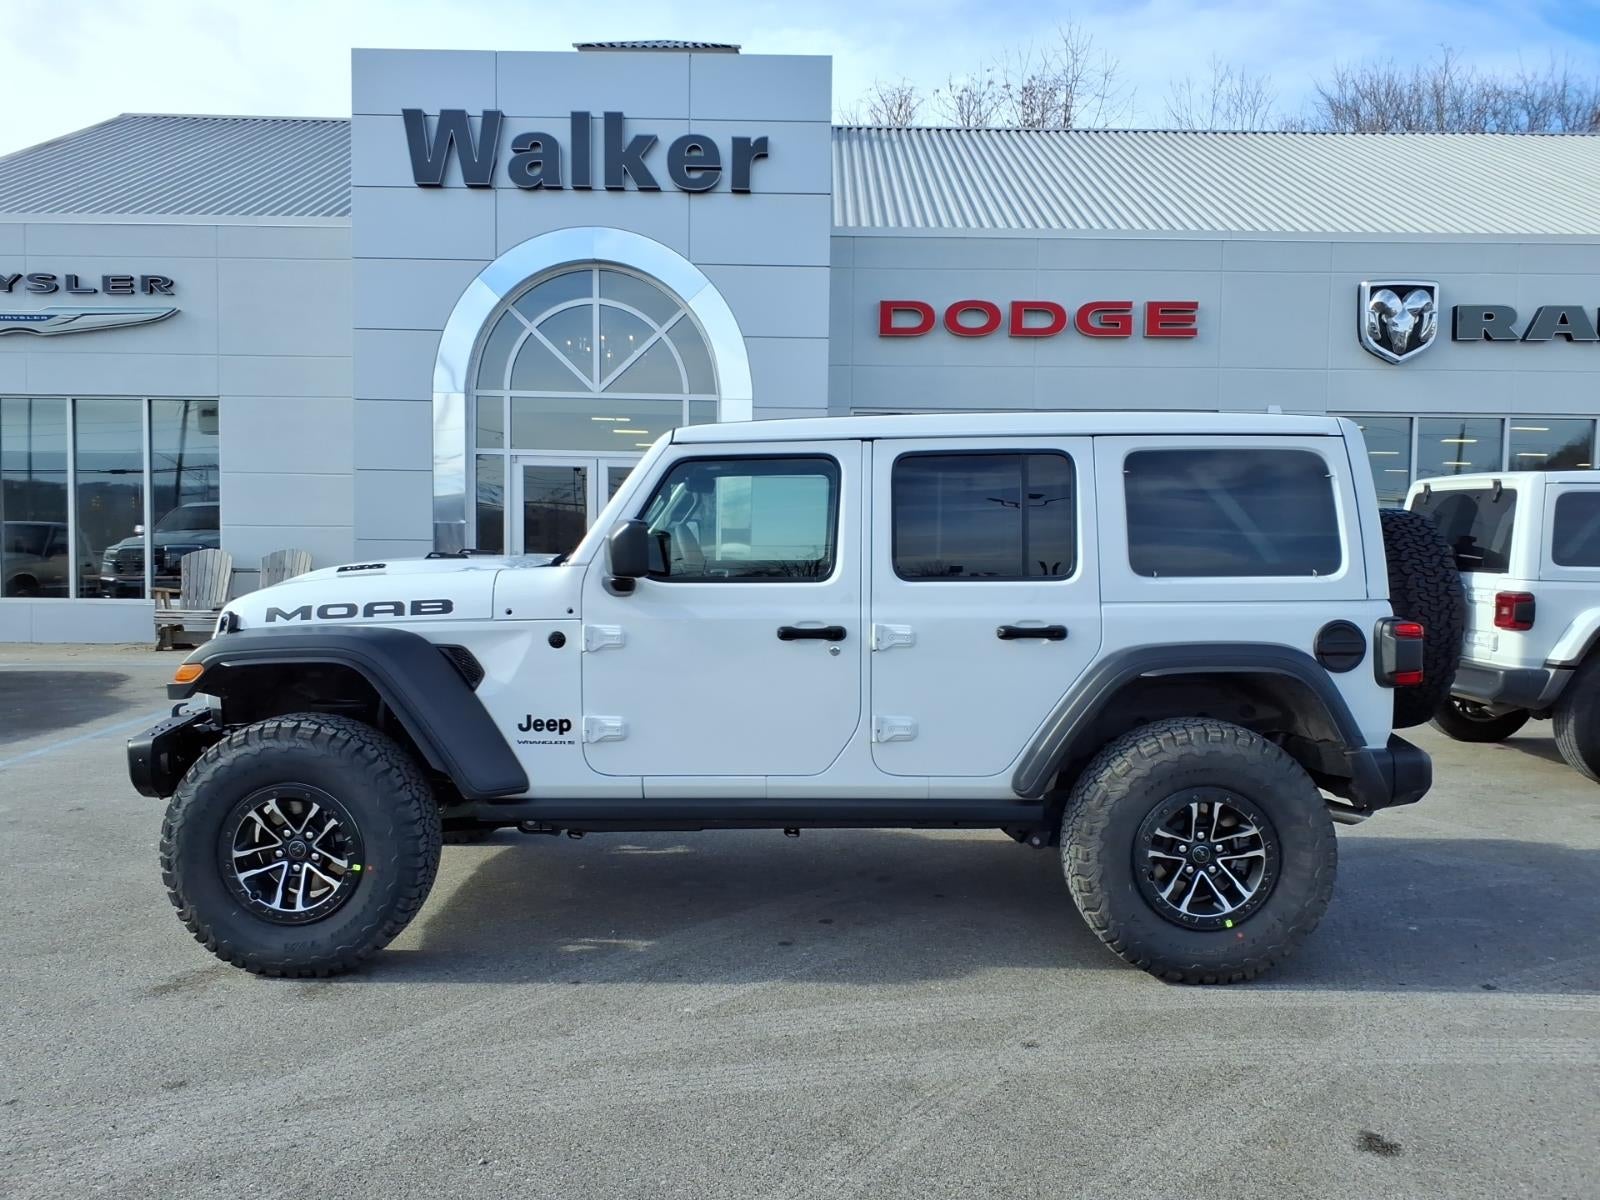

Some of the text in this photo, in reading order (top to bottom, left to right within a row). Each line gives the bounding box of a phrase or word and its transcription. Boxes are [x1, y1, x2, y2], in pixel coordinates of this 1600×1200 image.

[401, 108, 768, 193] Walker
[878, 300, 1199, 338] DODGE
[1452, 304, 1600, 341] RA
[265, 598, 454, 623] MOAB
[517, 714, 572, 735] Jeep
